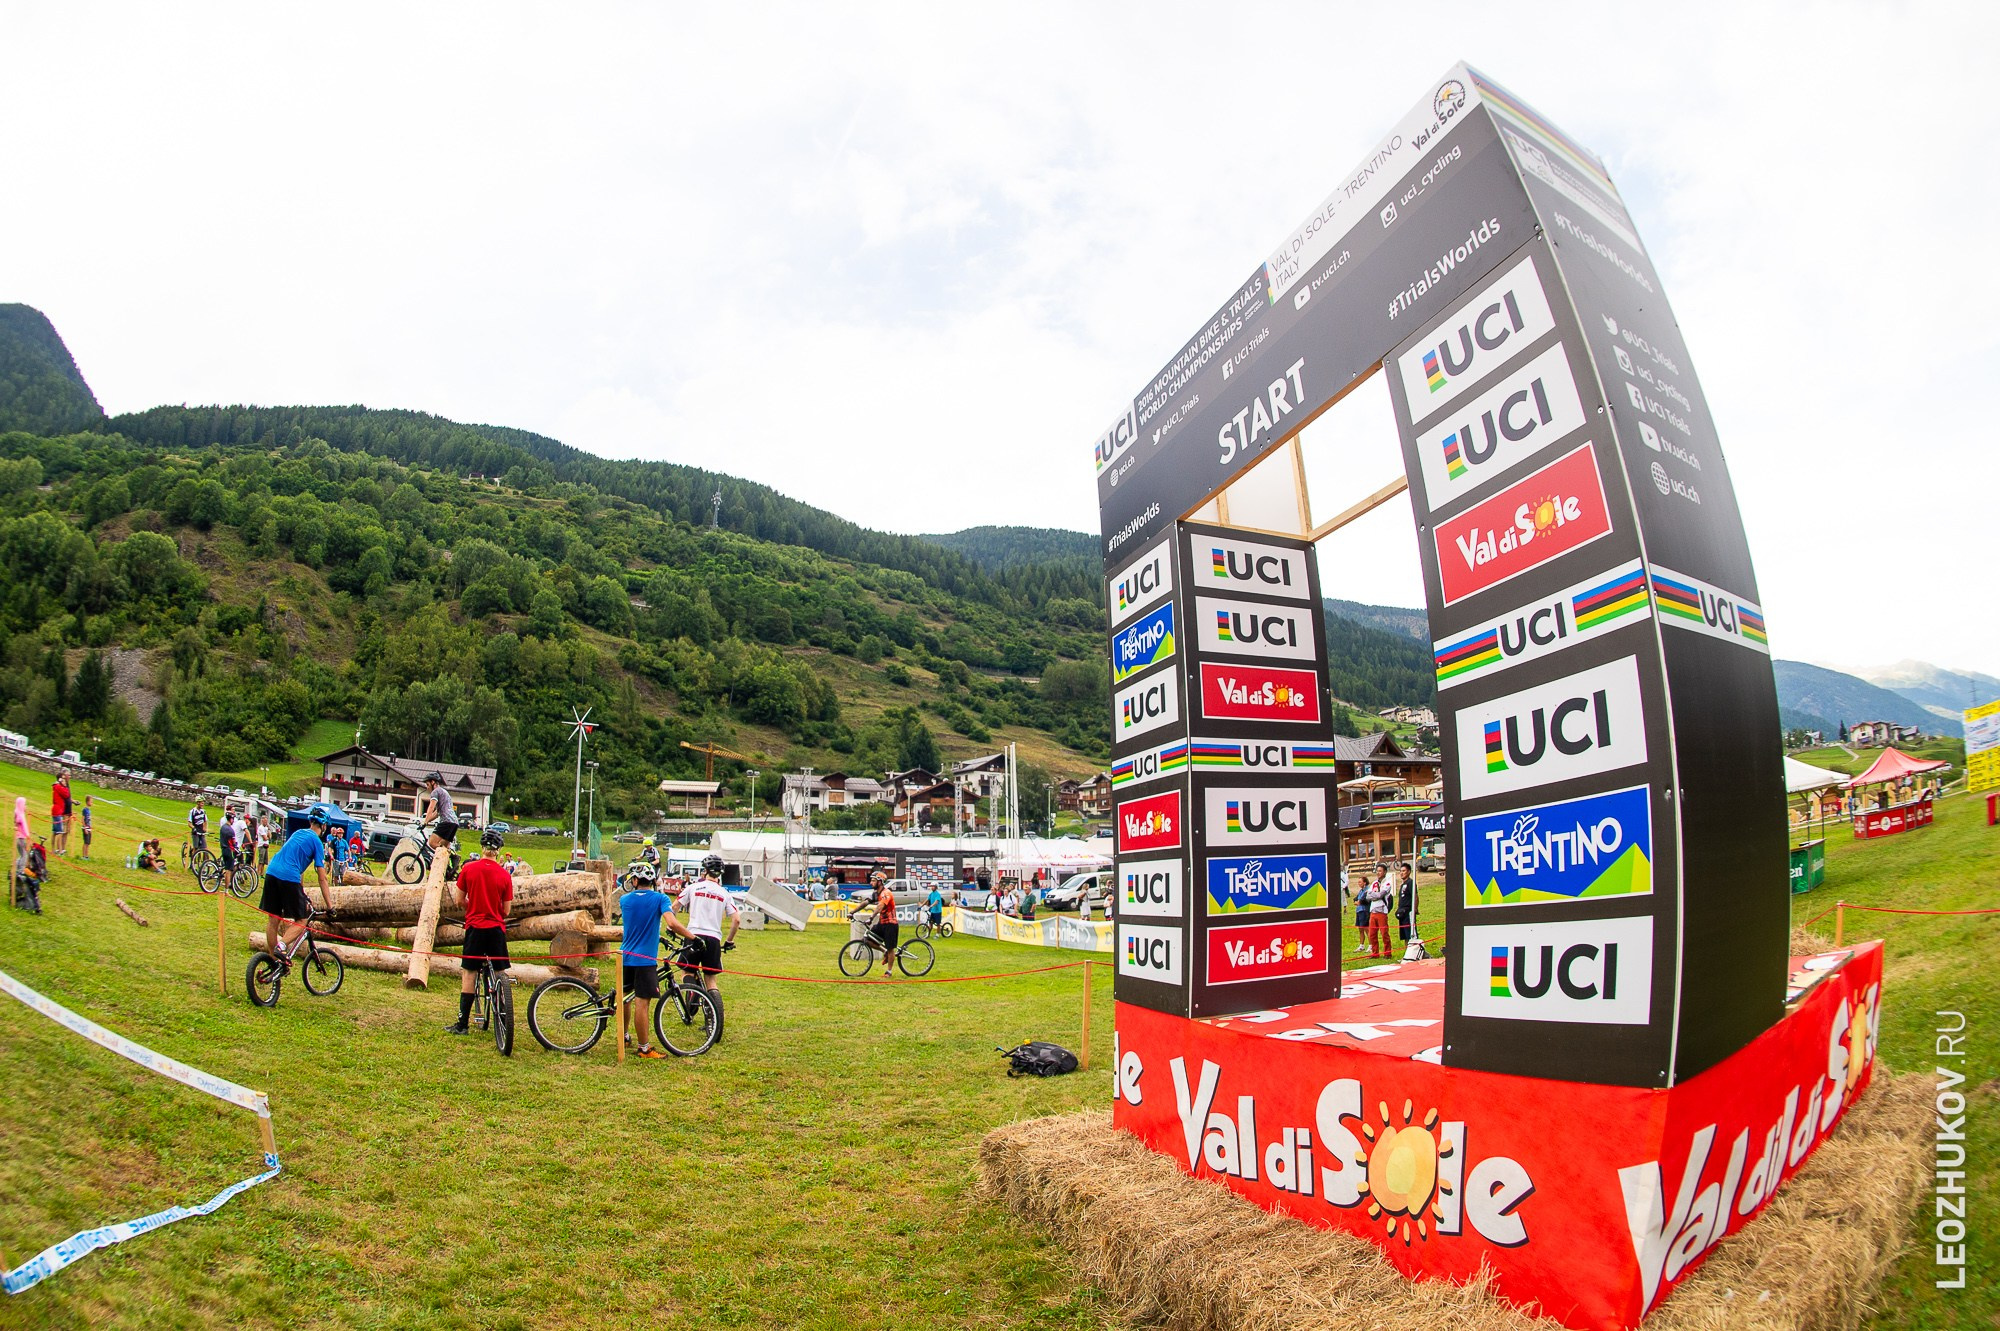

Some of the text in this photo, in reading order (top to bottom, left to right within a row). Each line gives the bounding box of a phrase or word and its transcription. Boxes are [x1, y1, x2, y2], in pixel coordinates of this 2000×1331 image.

[1412, 98, 1465, 151] Val di Sole
[1400, 145, 1461, 206] uci_cycling
[1271, 249, 1292, 272] VAL
[1292, 234, 1305, 253] DI
[1305, 203, 1336, 240] SOLE
[1343, 135, 1402, 200] TRENTINO
[1275, 256, 1300, 290] ITALY
[1311, 250, 1350, 291] tv.uci.ch
[1388, 217, 1501, 320] #TrialsWorlds
[1137, 388, 1154, 412] 2016
[1153, 342, 1199, 395] MOUNTAIN
[1200, 321, 1220, 348] BIKE
[1221, 313, 1229, 326] &
[1228, 278, 1262, 318] TRIALS
[1234, 327, 1270, 365] UCI Trials
[1438, 289, 1525, 377] UCI
[1139, 317, 1243, 426] WORLD CHAMPIONSHIPS
[1162, 393, 1199, 435] @UCI_Trials
[1218, 357, 1305, 465] START
[1460, 377, 1553, 465] UCI
[1646, 396, 1691, 436] UCI Trials
[1101, 411, 1135, 462] UCI
[1661, 436, 1701, 471] tv.uci.ch
[1118, 455, 1135, 477] uci.ch
[1670, 478, 1701, 505] uci.ch
[1108, 502, 1160, 553] #TrialsWorlds
[1456, 494, 1582, 572] Val di Sole
[1125, 558, 1160, 604] UCI
[1227, 550, 1291, 586] UCI
[1232, 612, 1297, 647] UCI
[1500, 601, 1568, 656] UCI
[1699, 590, 1738, 635] UCI
[1119, 619, 1164, 661] TRENTINO
[1130, 682, 1166, 724] UCI
[1217, 677, 1305, 708] Val di Sole
[1506, 689, 1611, 767] UCI
[1134, 753, 1157, 779] UCI
[1243, 745, 1287, 767] UCI
[1125, 810, 1172, 839] Val di Sole
[1242, 800, 1308, 832] UCI
[1419, 816, 1434, 830] Val
[1435, 821, 1441, 829] di
[1486, 816, 1623, 876] TRENTINO
[1134, 872, 1170, 904] UCI
[1225, 866, 1312, 897] TRENTINO
[1135, 937, 1170, 970] UCI
[1224, 937, 1313, 969] Val di Sole
[1513, 943, 1618, 1000] UCI
[1169, 1056, 1536, 1248] Val di Sole
[1617, 1123, 1750, 1319] Val
